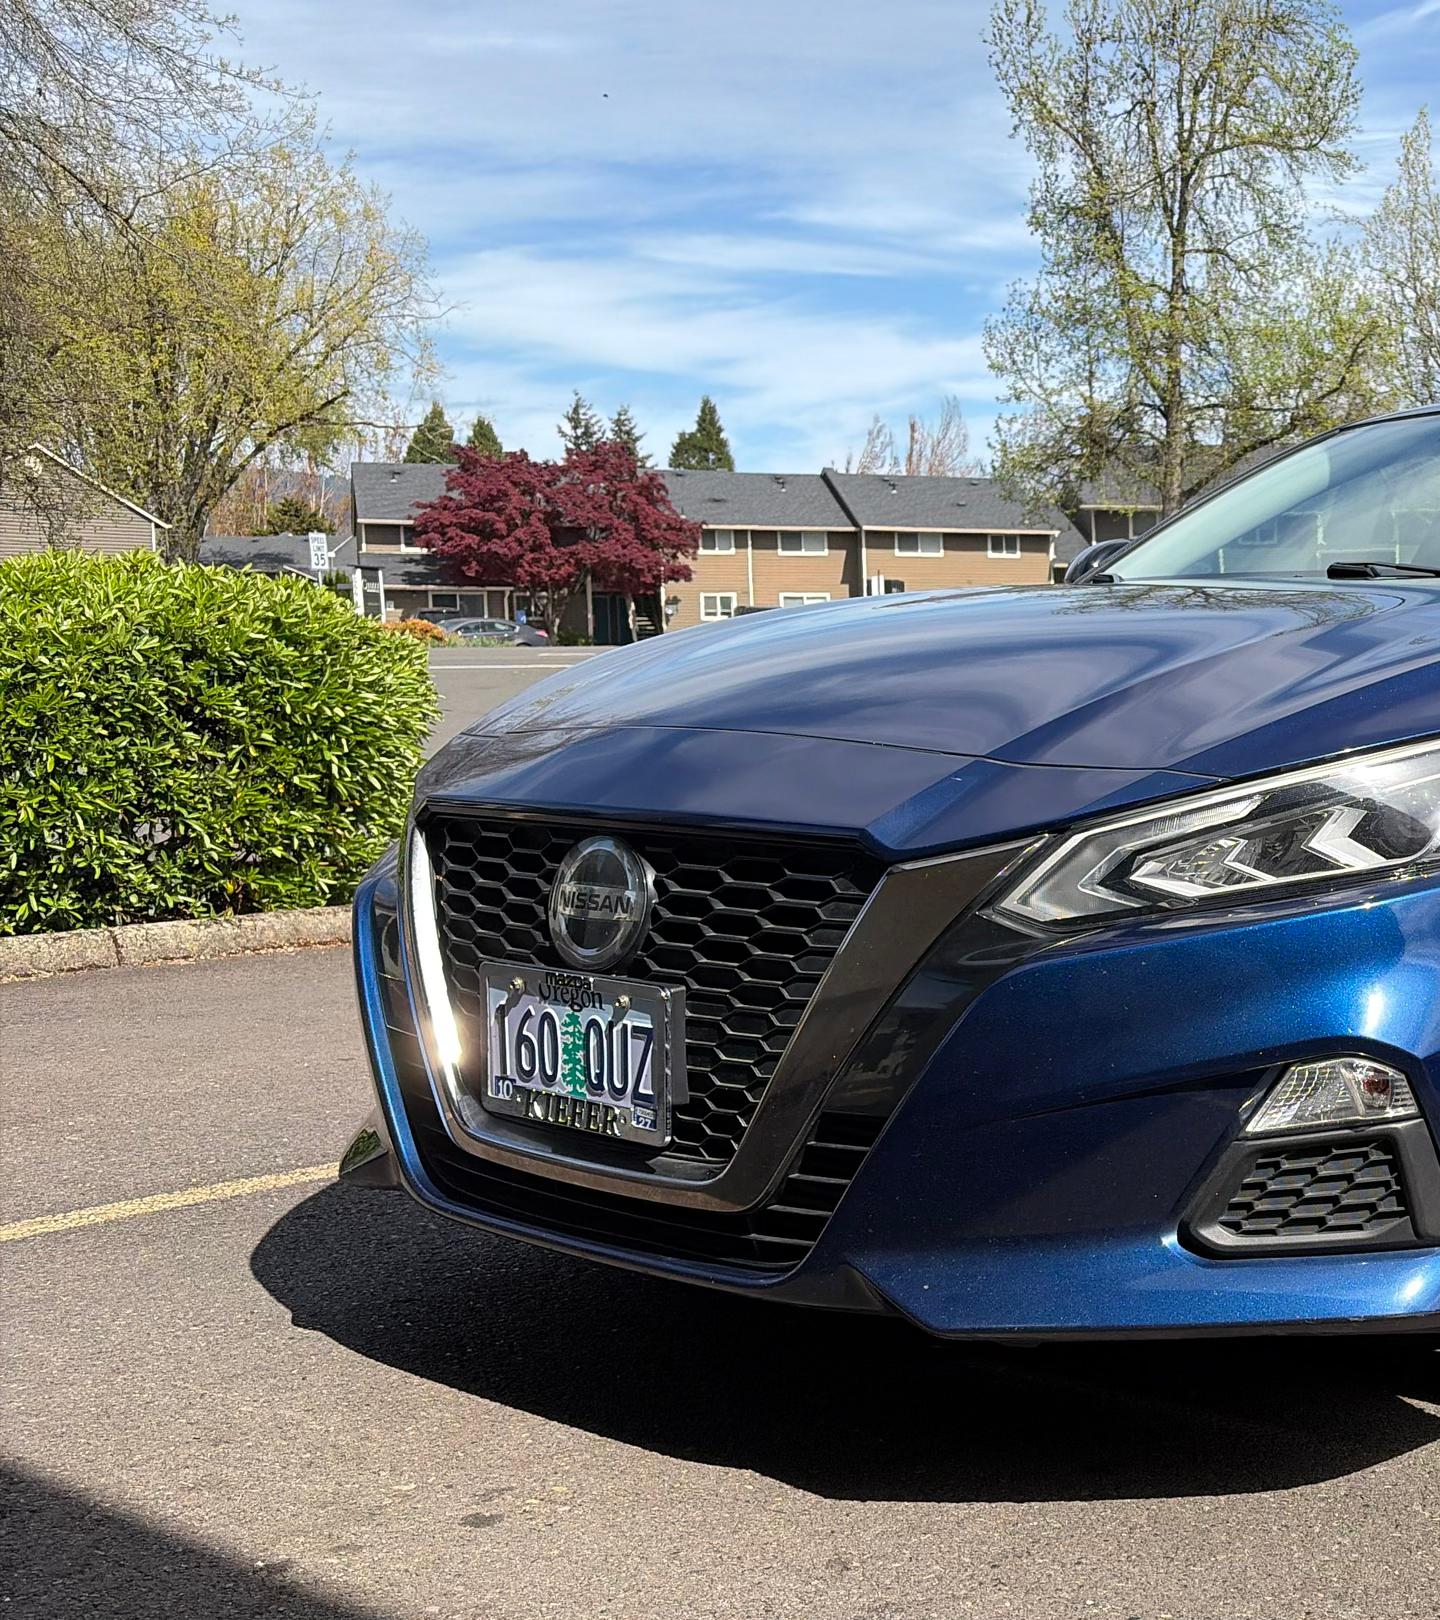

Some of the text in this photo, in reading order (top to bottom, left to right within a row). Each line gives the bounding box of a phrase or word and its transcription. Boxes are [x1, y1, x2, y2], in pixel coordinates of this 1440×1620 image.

[314, 553, 326, 567] 35
[560, 889, 630, 914] NISSAN
[538, 980, 605, 1012] Oregon
[496, 1004, 559, 1085] 160
[499, 1080, 513, 1099] 10
[525, 1087, 621, 1137] KIEFER
[638, 1116, 652, 1129] 27
